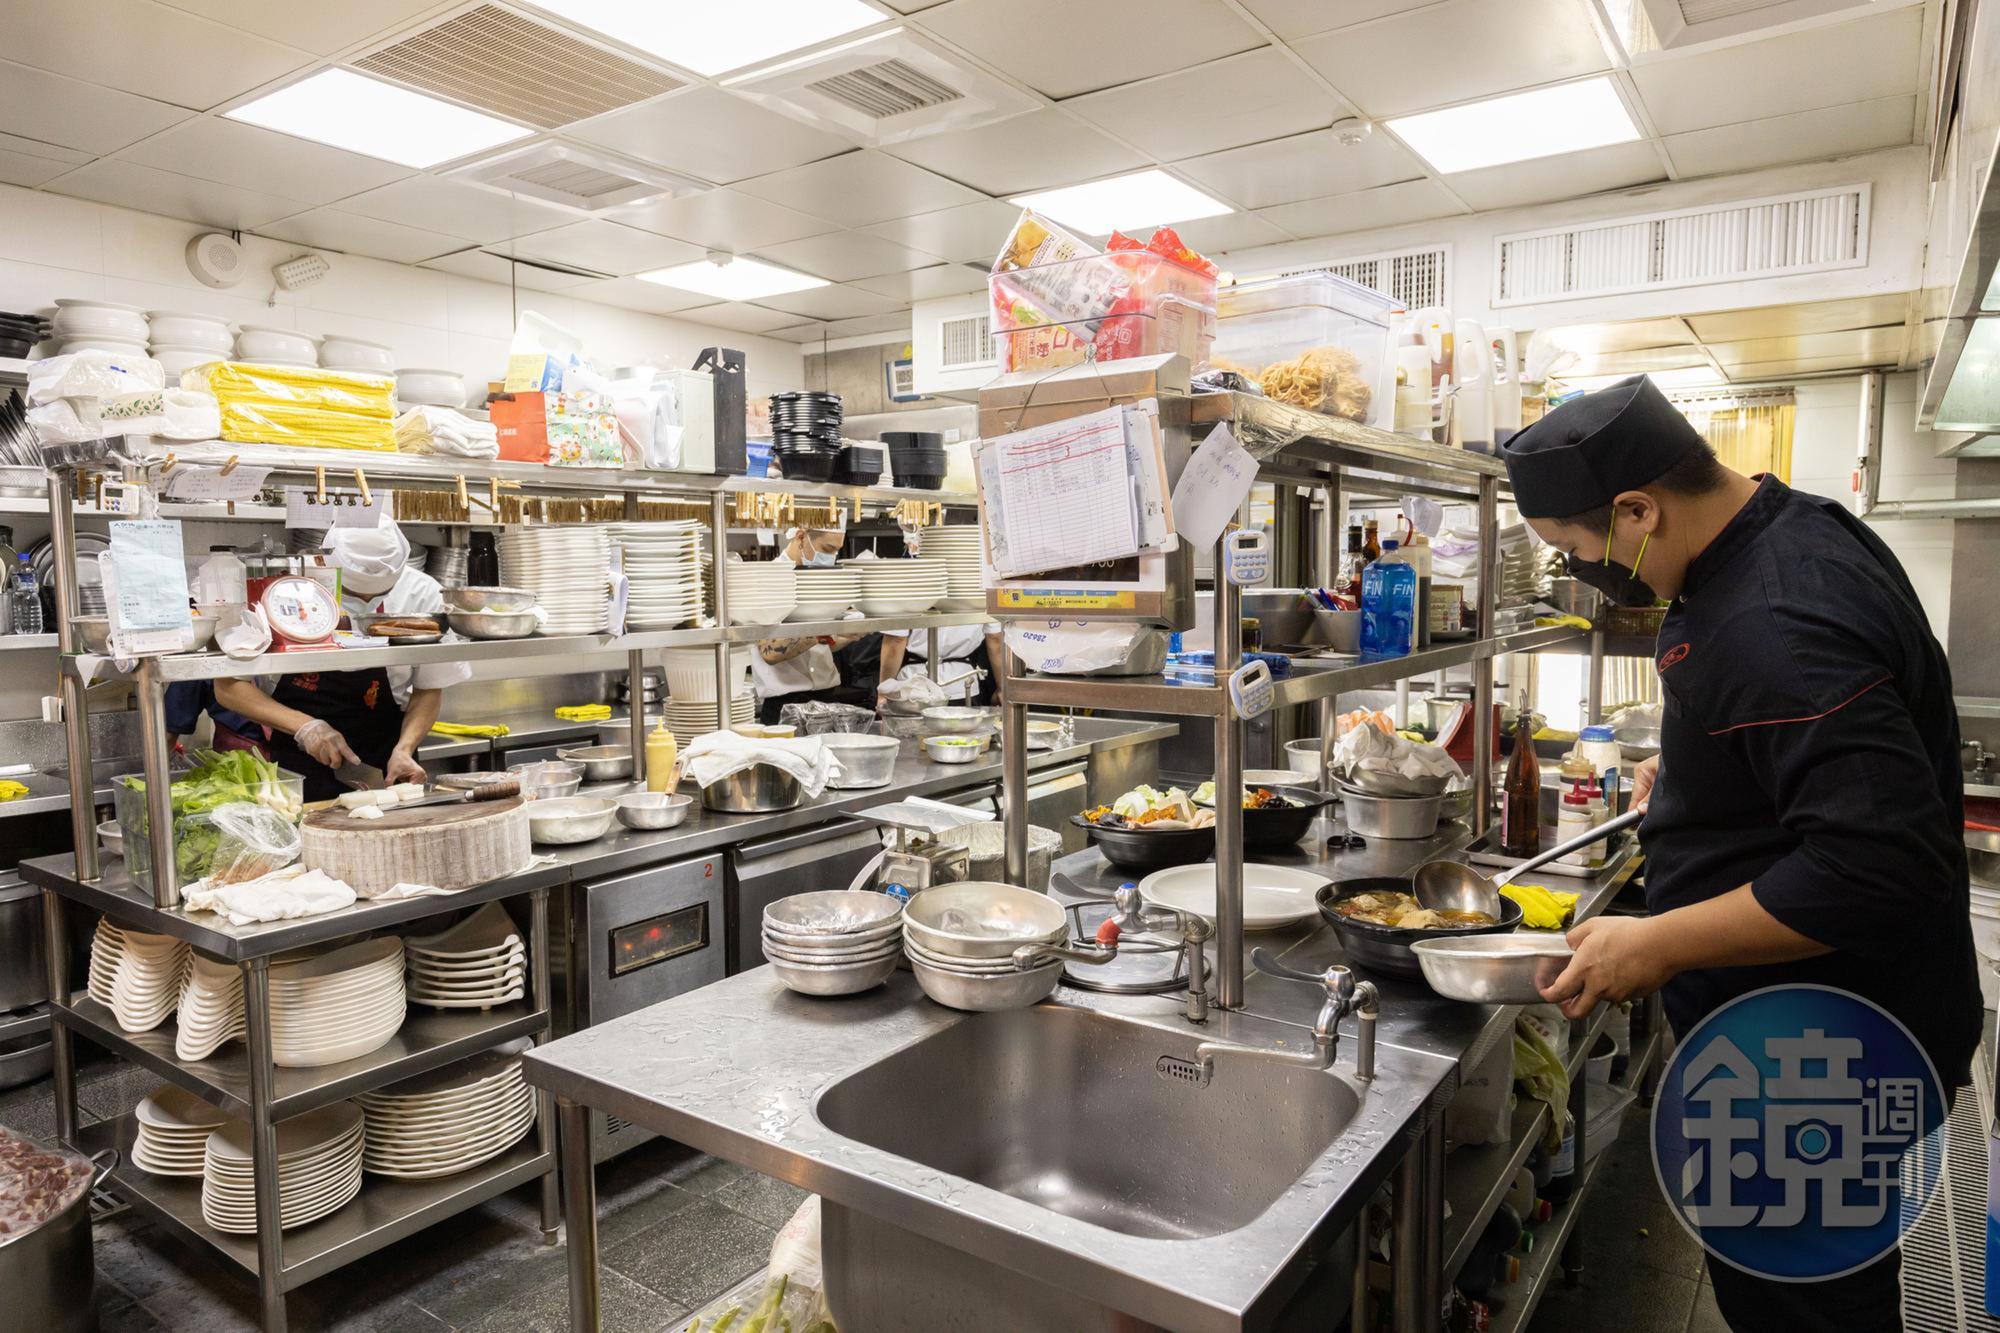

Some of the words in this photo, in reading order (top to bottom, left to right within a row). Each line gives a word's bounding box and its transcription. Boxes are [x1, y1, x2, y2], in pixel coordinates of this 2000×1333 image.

[1365, 580, 1383, 595] FIN
[1392, 584, 1415, 595] FIN
[1023, 632, 1046, 642] 28620
[704, 863, 713, 877] 2
